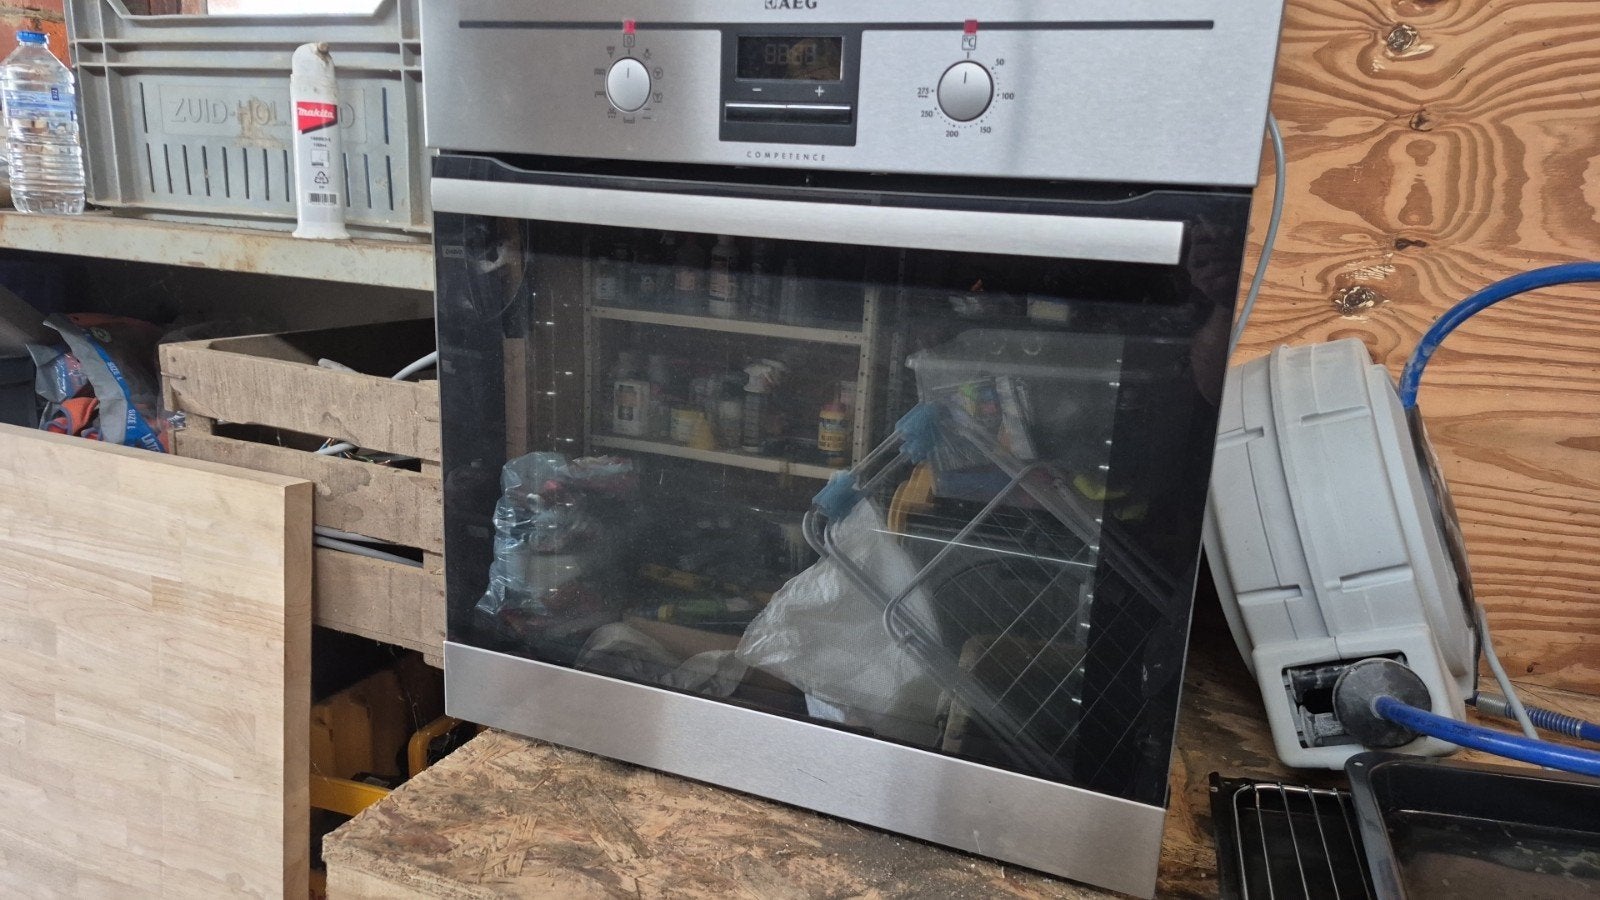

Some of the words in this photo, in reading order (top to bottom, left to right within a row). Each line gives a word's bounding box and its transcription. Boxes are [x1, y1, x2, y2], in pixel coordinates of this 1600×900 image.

[777, 0, 817, 9] AEG
[995, 58, 1005, 66] 50
[917, 87, 929, 95] 275
[1002, 92, 1015, 100] 100
[169, 98, 355, 129] ZUID-HOLD
[920, 110, 933, 118] 250
[945, 130, 959, 138] 200
[746, 150, 825, 161] COMPETENCE
[127, 409, 137, 424] SIZE
